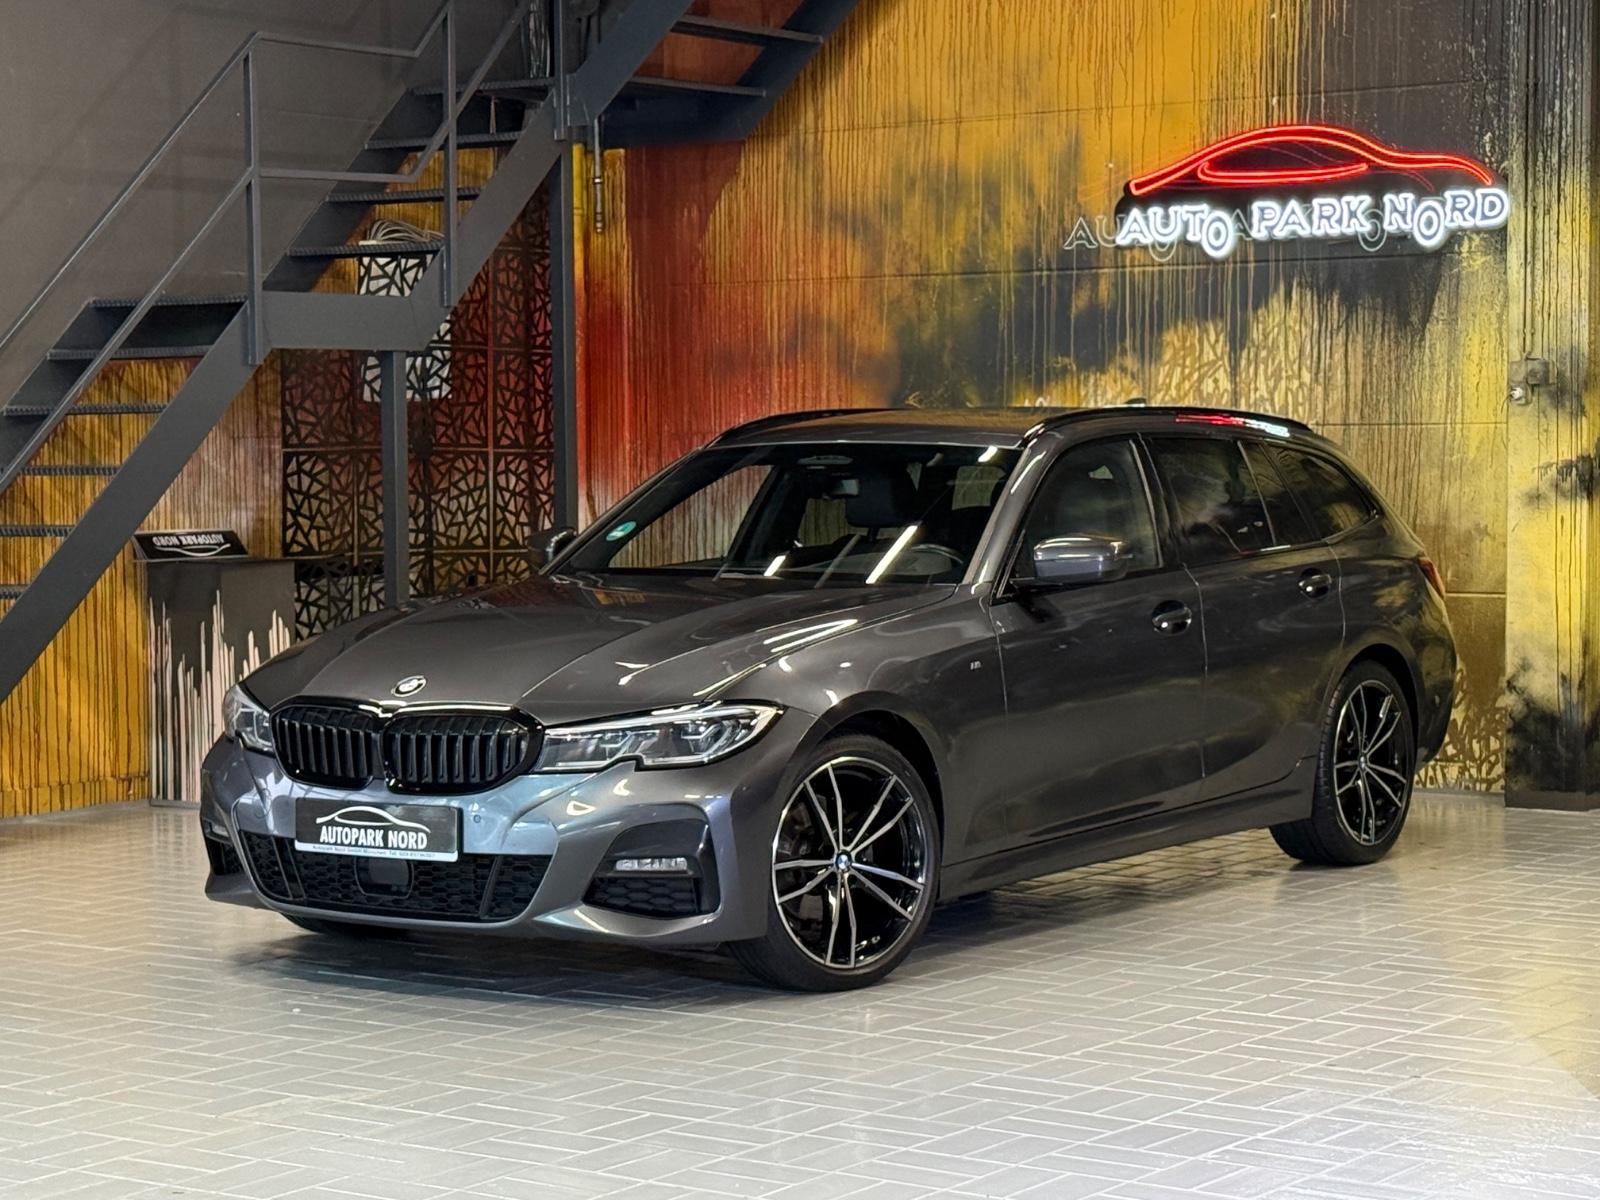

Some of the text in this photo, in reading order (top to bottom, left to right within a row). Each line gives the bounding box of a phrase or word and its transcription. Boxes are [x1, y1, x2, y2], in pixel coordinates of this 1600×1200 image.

[1115, 203, 1234, 258] AUTO
[1251, 194, 1372, 239] PARK
[1383, 188, 1509, 247] NORD
[320, 825, 428, 850] AUTOPARK NORD
